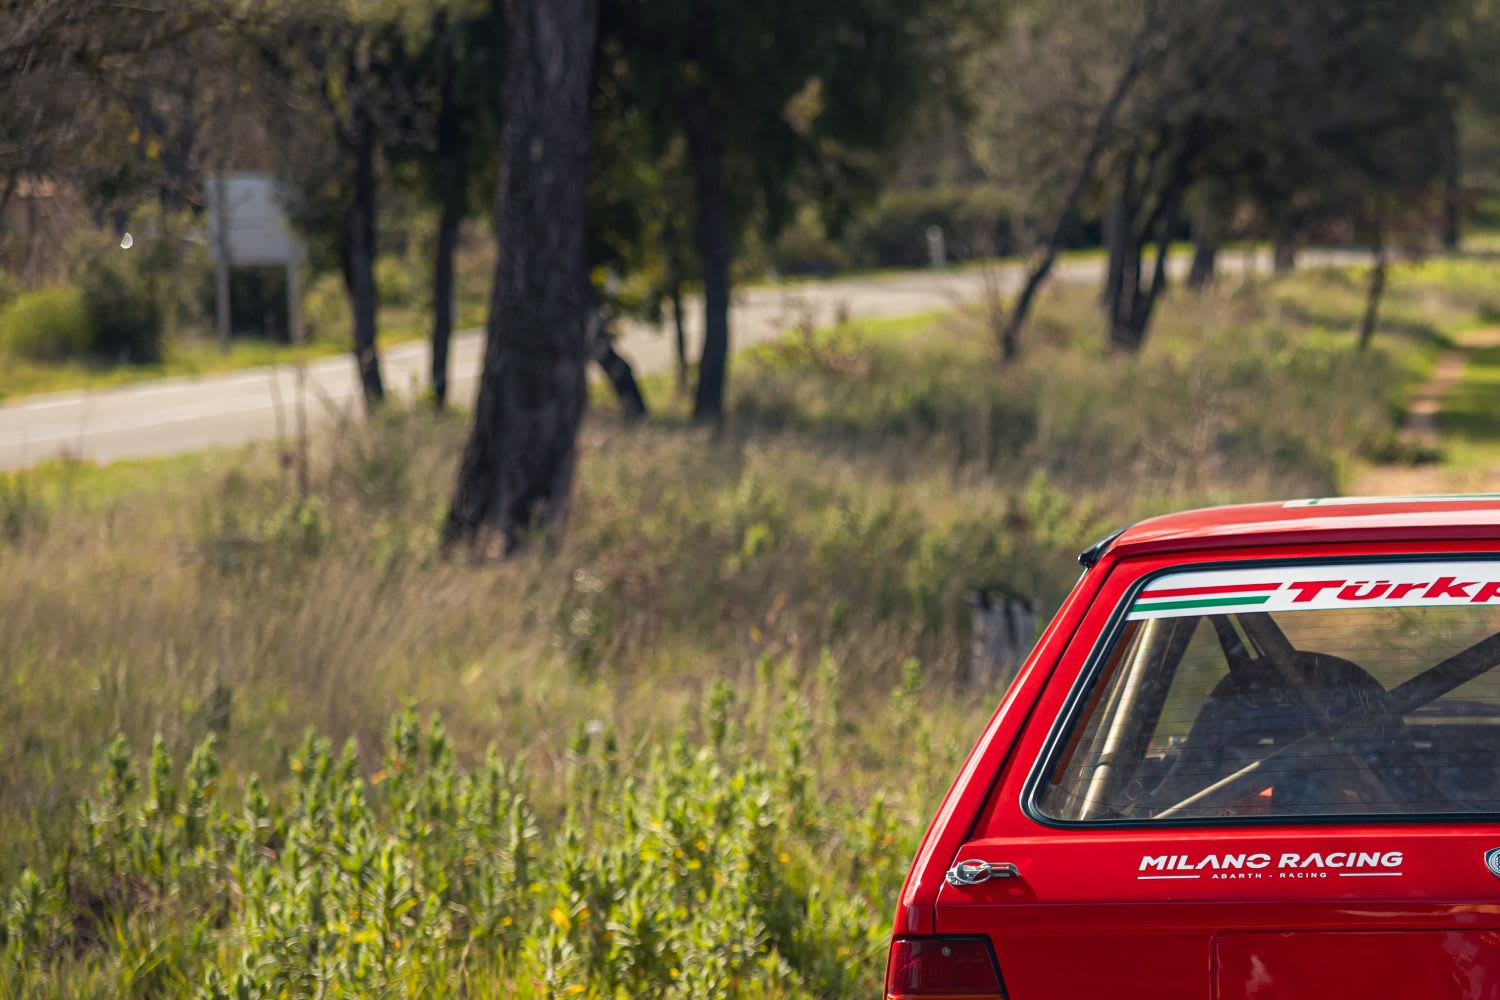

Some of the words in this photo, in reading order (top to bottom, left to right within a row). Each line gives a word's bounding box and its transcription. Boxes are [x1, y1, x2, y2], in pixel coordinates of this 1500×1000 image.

[1138, 853, 1272, 871] MILANO
[1277, 851, 1404, 869] RACING
[1211, 872, 1262, 880] ABARTH
[1279, 871, 1328, 879] RACING
